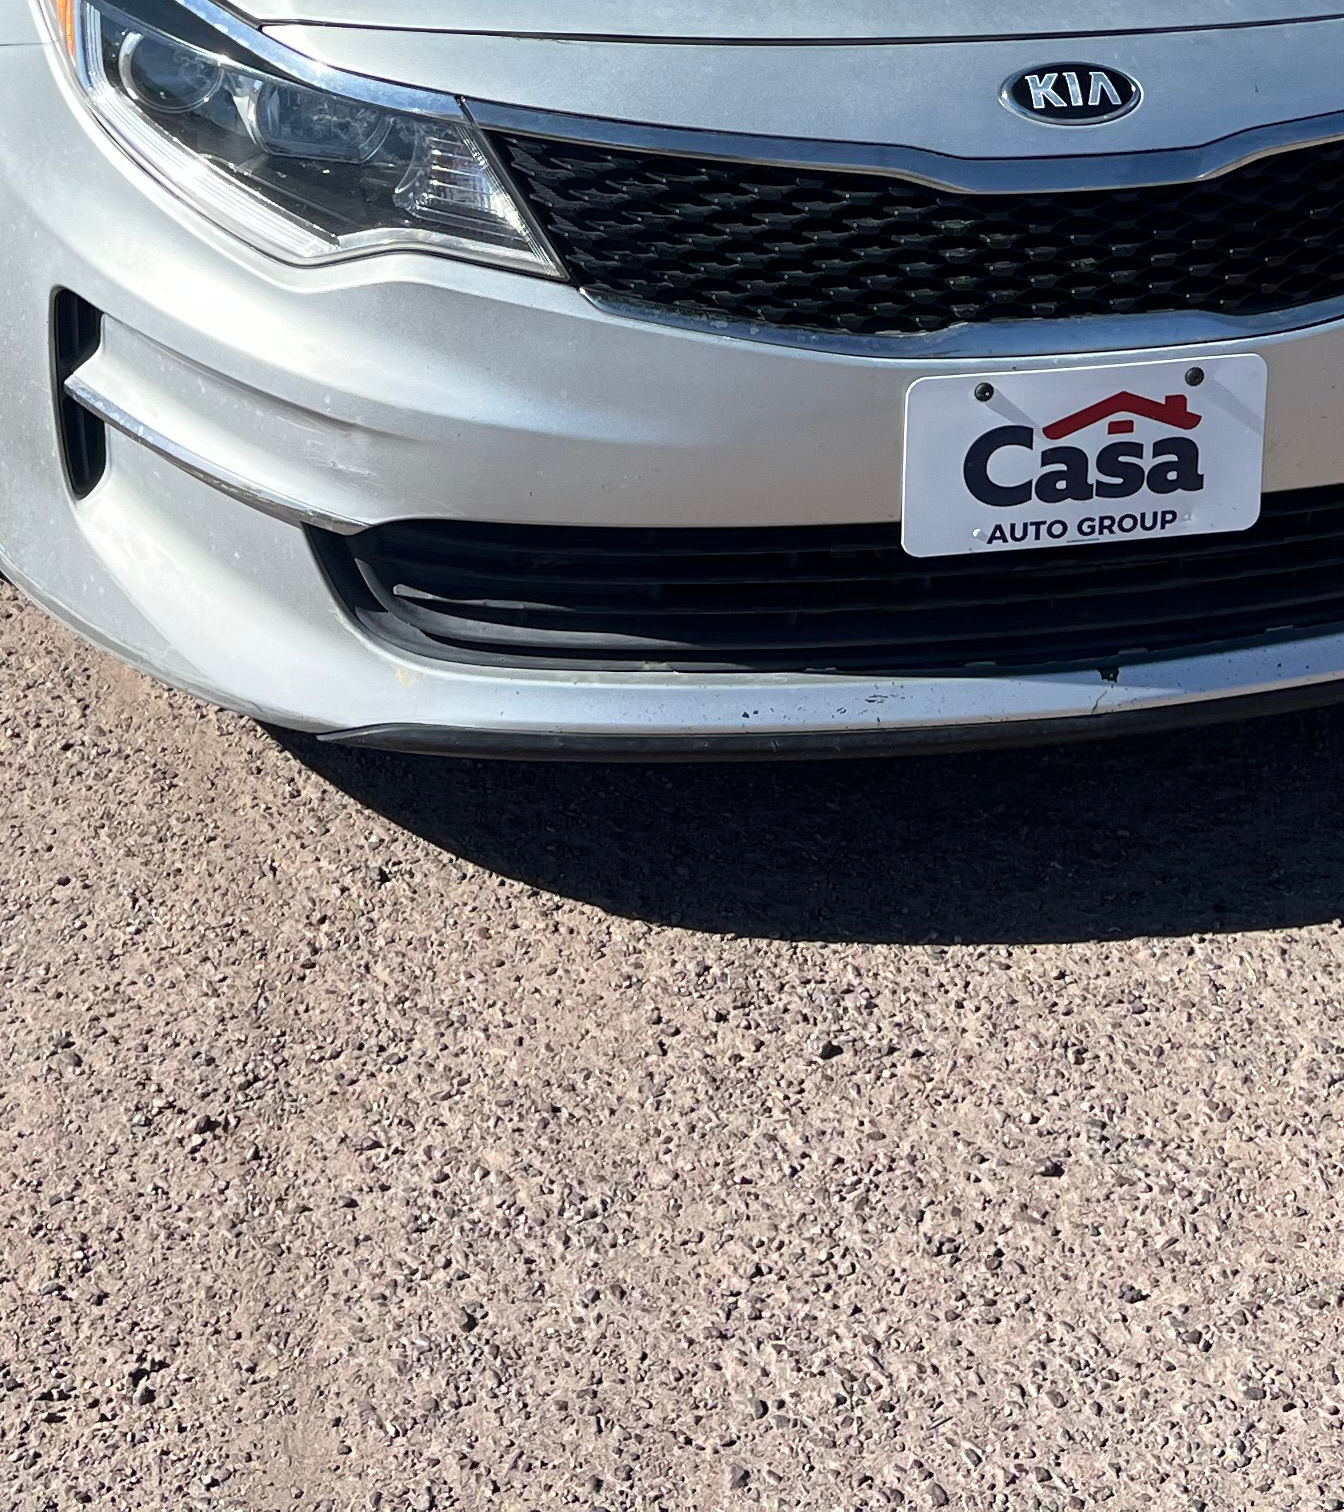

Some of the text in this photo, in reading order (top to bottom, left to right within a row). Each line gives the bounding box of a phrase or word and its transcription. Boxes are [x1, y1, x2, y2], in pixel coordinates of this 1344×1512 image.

[1024, 71, 1123, 109] KIA
[963, 424, 1205, 508] Casa
[986, 509, 1178, 545] AUTO GROUP
